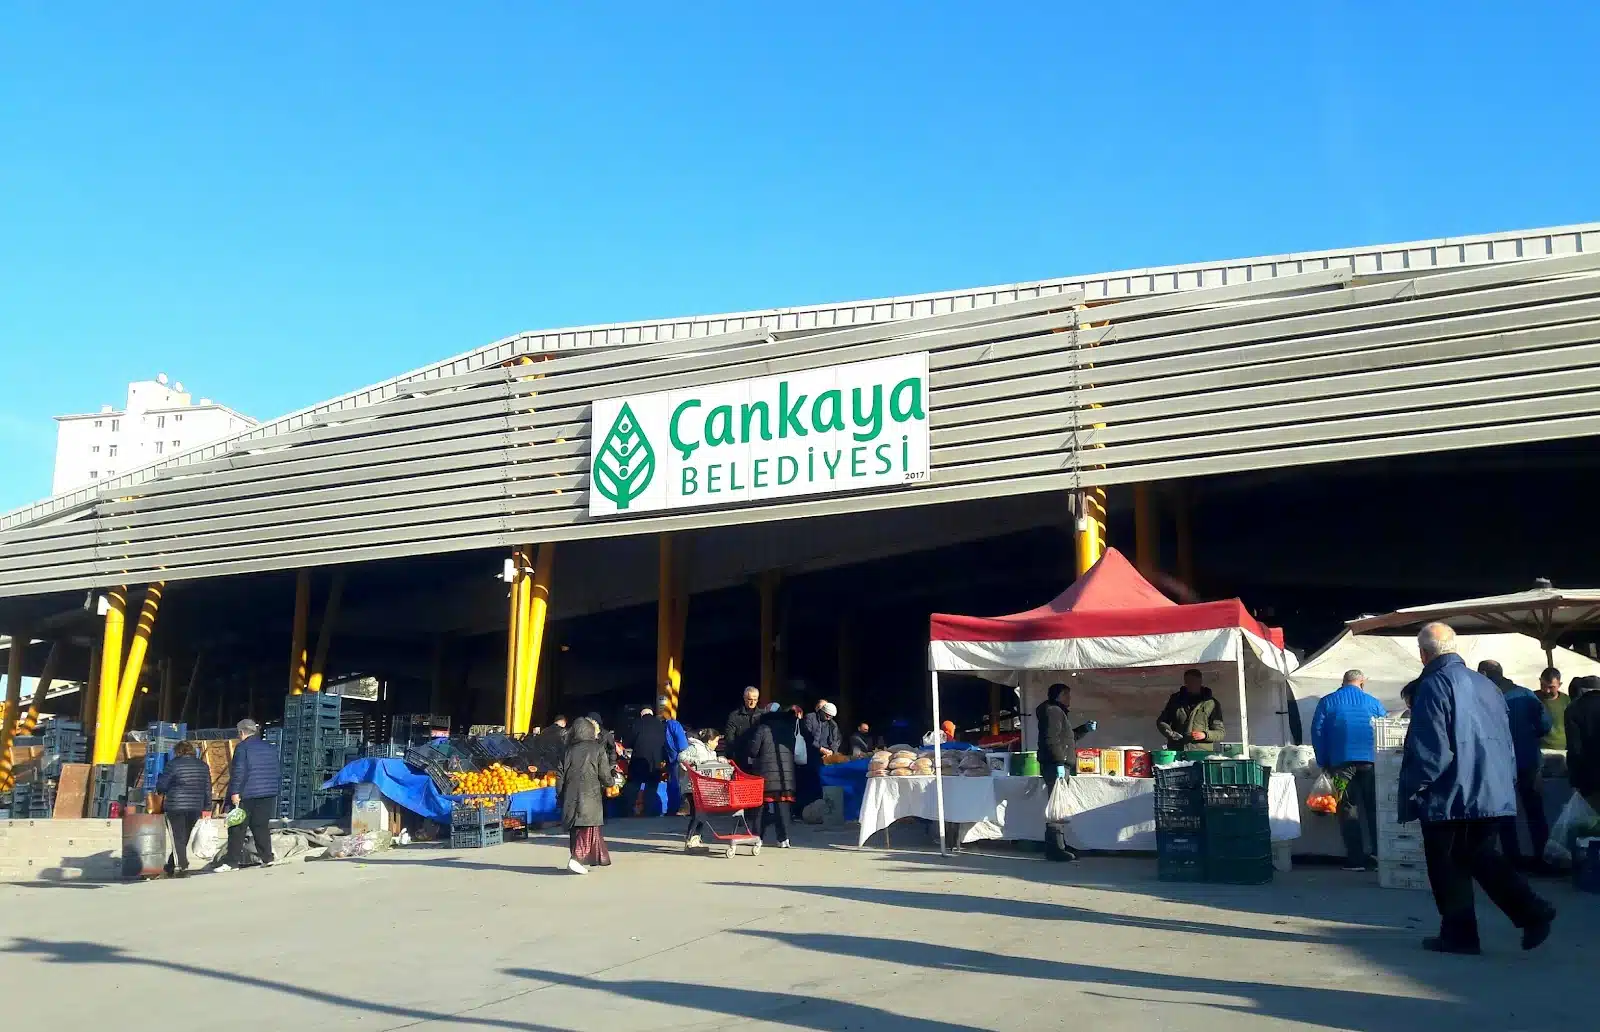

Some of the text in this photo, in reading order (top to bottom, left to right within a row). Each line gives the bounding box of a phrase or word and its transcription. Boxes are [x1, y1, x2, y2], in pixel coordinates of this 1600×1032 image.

[669, 377, 925, 461] Çankaya
[681, 435, 909, 495] BELEDİYESİ
[905, 471, 924, 479] 2017
